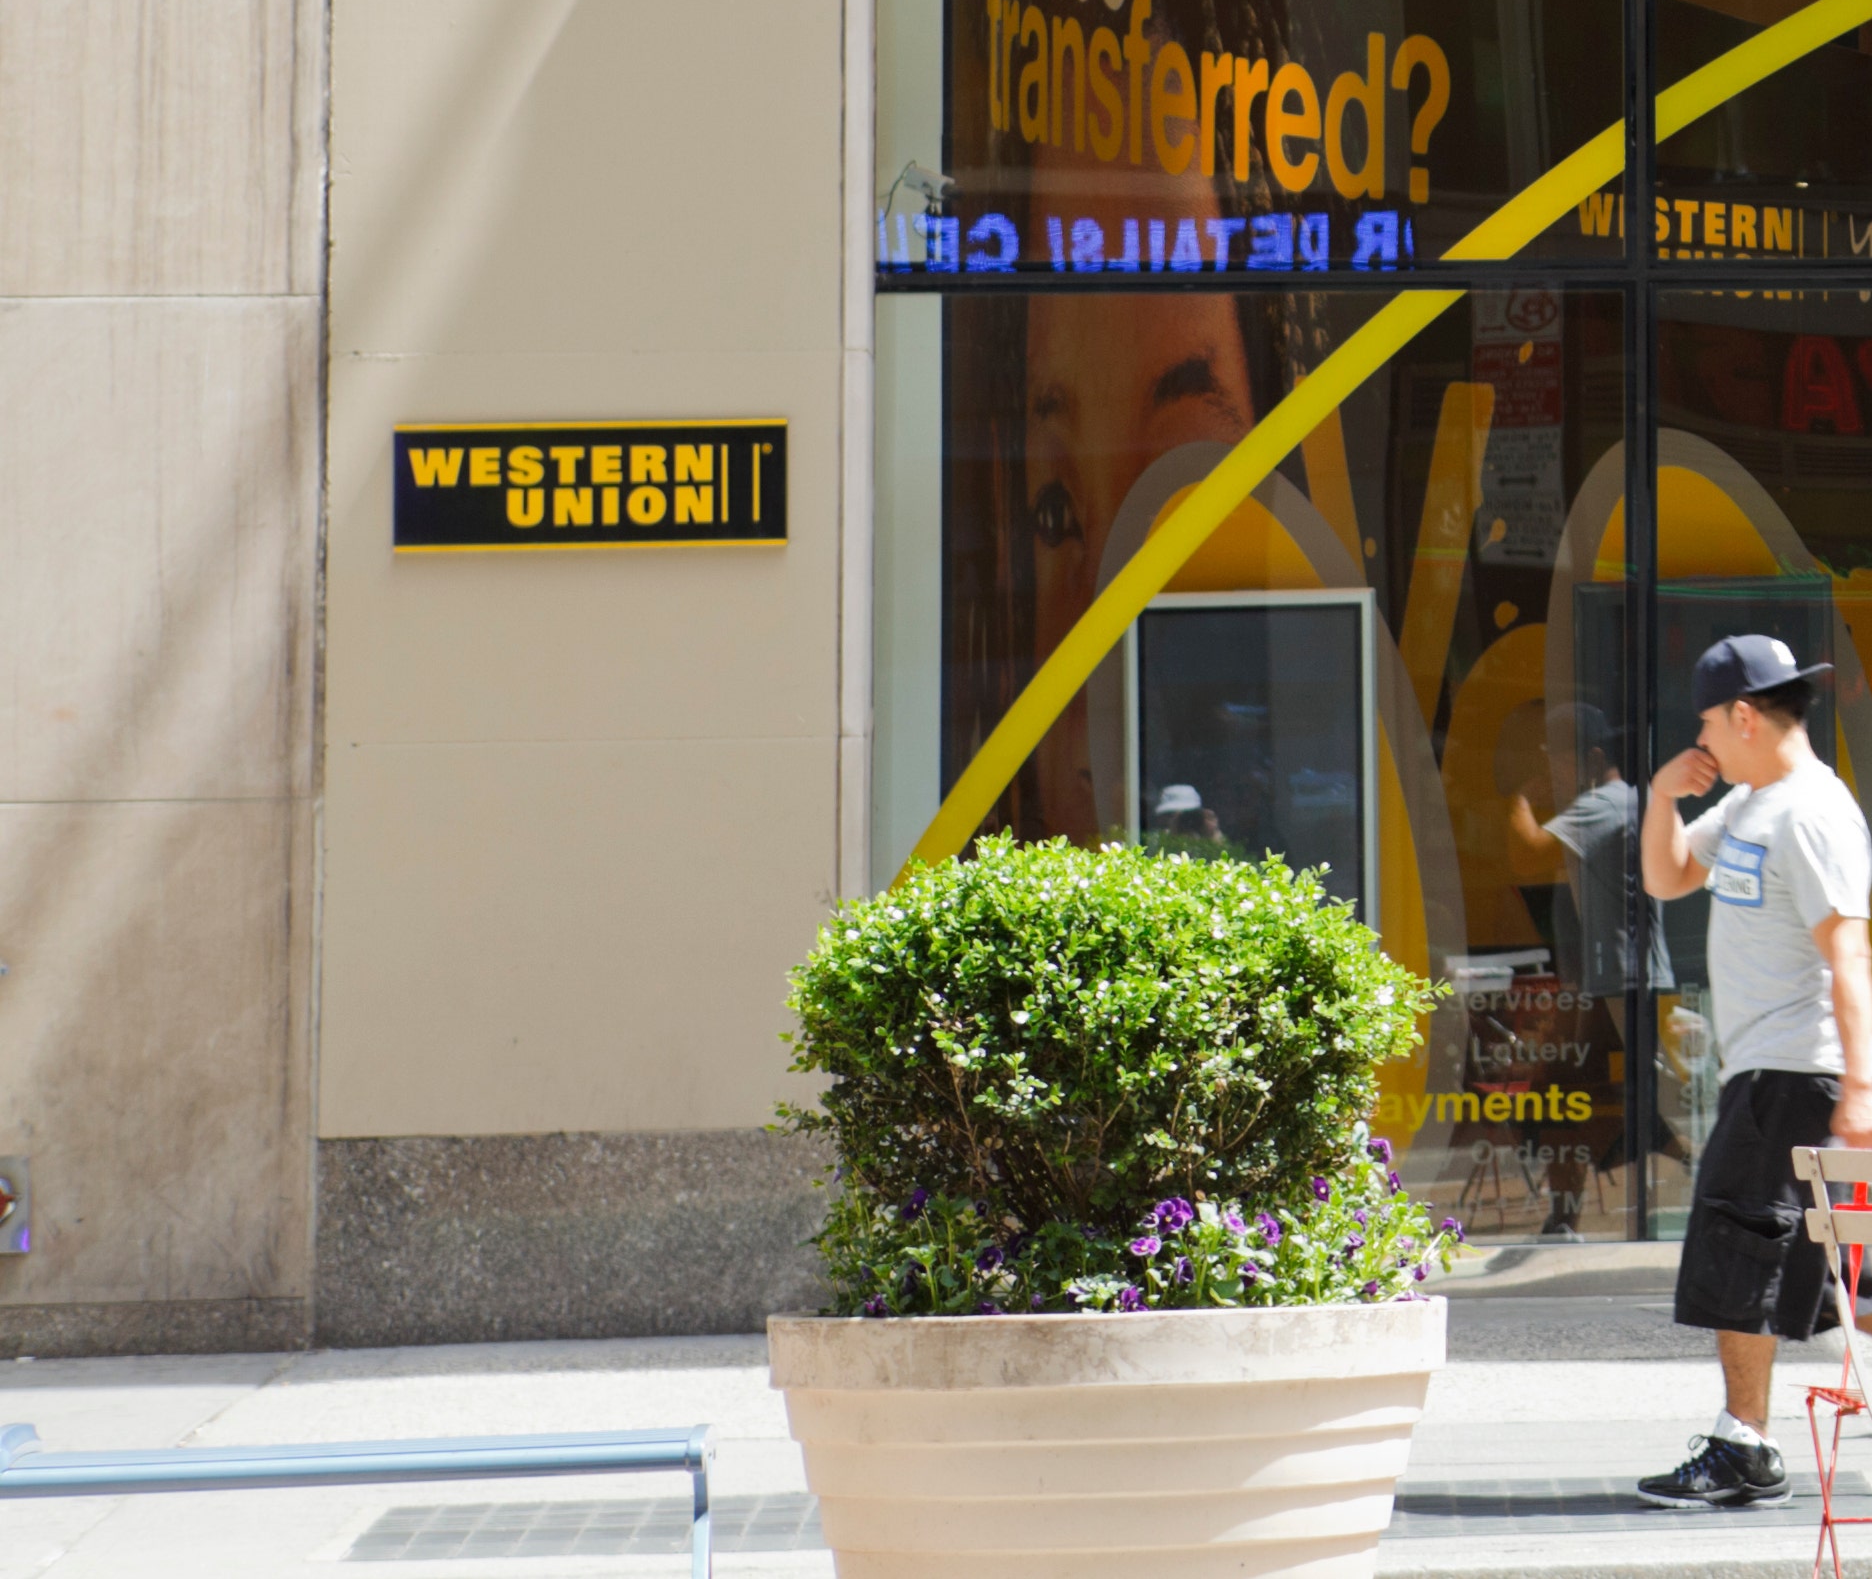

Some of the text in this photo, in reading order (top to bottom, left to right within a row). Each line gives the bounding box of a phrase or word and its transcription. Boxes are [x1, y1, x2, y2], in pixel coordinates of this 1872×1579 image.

[408, 444, 714, 488] WESTERN
[507, 485, 713, 528] UNION
[1472, 1037, 1592, 1067] Lottery
[1379, 1083, 1593, 1133] ayments
